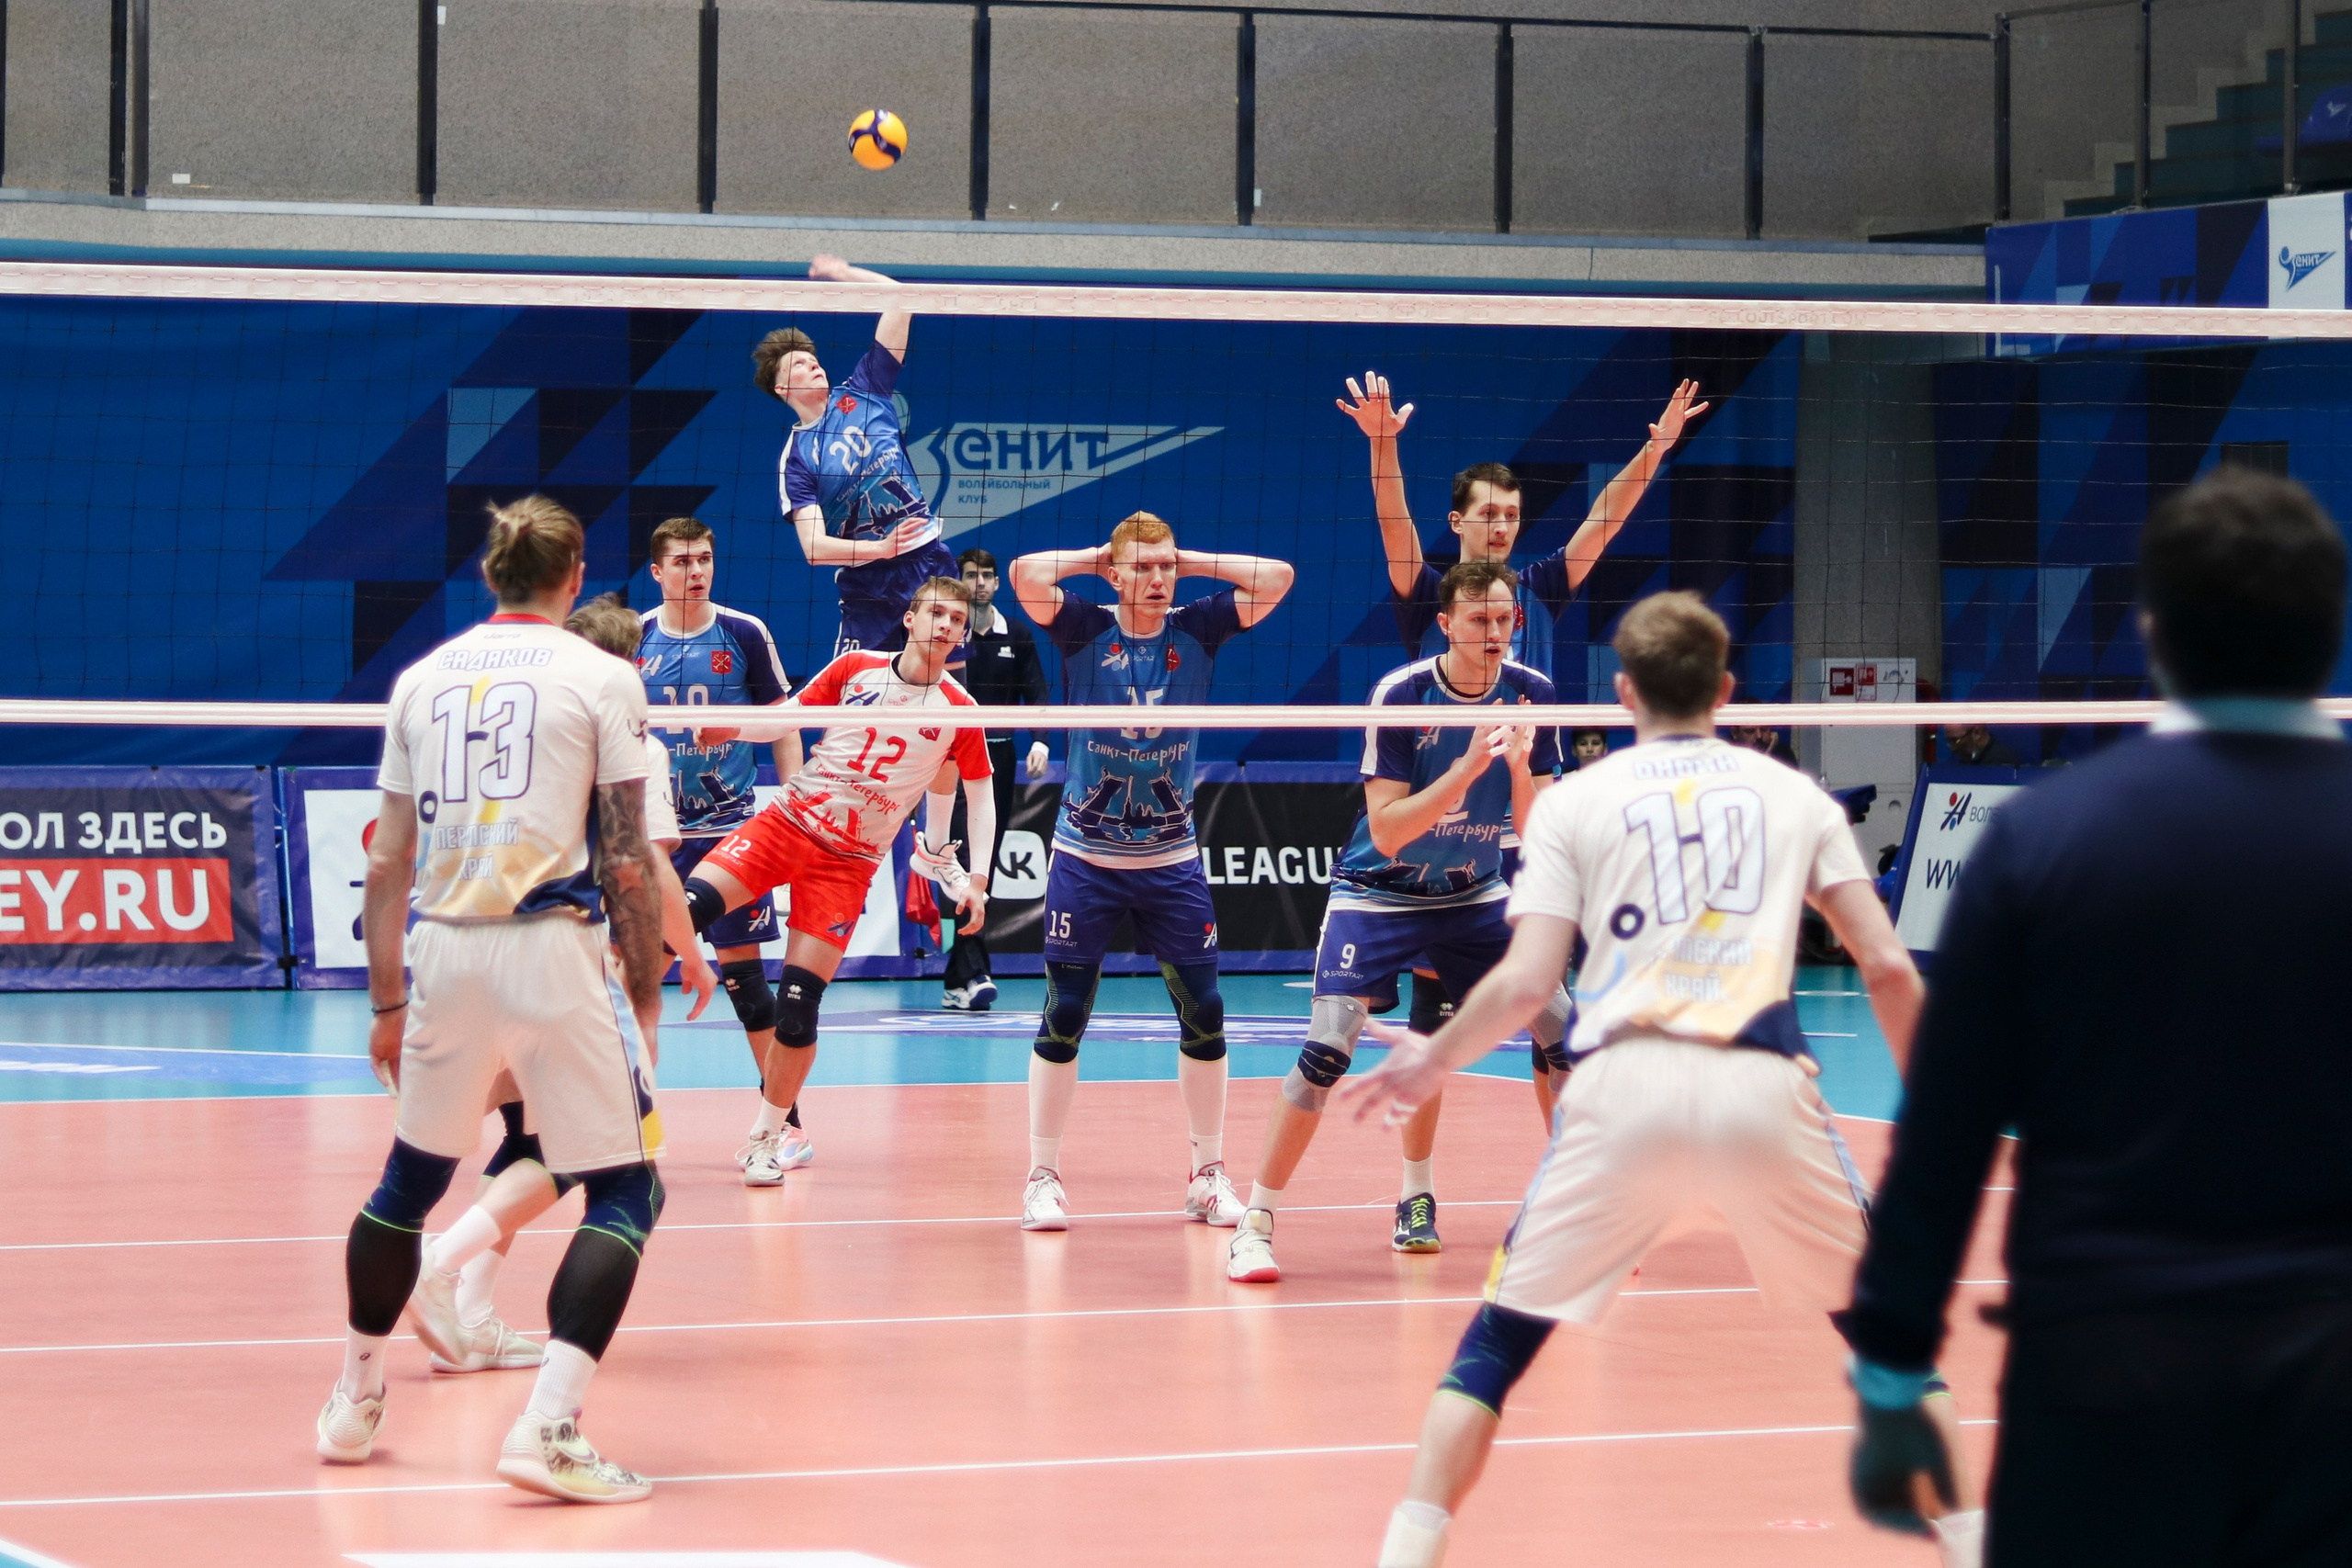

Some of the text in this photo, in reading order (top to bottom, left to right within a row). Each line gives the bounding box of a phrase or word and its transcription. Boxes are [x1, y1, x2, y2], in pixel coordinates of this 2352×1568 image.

[829, 425, 872, 476] 20
[957, 477, 1051, 491] ВОЛЕЙБОЛЬНЫЙ
[957, 494, 989, 505] КЛУБ
[431, 680, 537, 804] 13
[846, 726, 908, 784] 12
[78, 812, 228, 855] ЗДЕСЬ
[720, 834, 752, 859] 12
[1201, 846, 1342, 886] LEAGU
[1623, 786, 1766, 926] 10
[1048, 909, 1072, 939] 15
[1340, 942, 1356, 969] 9
[1329, 970, 1364, 980] SPORTART
